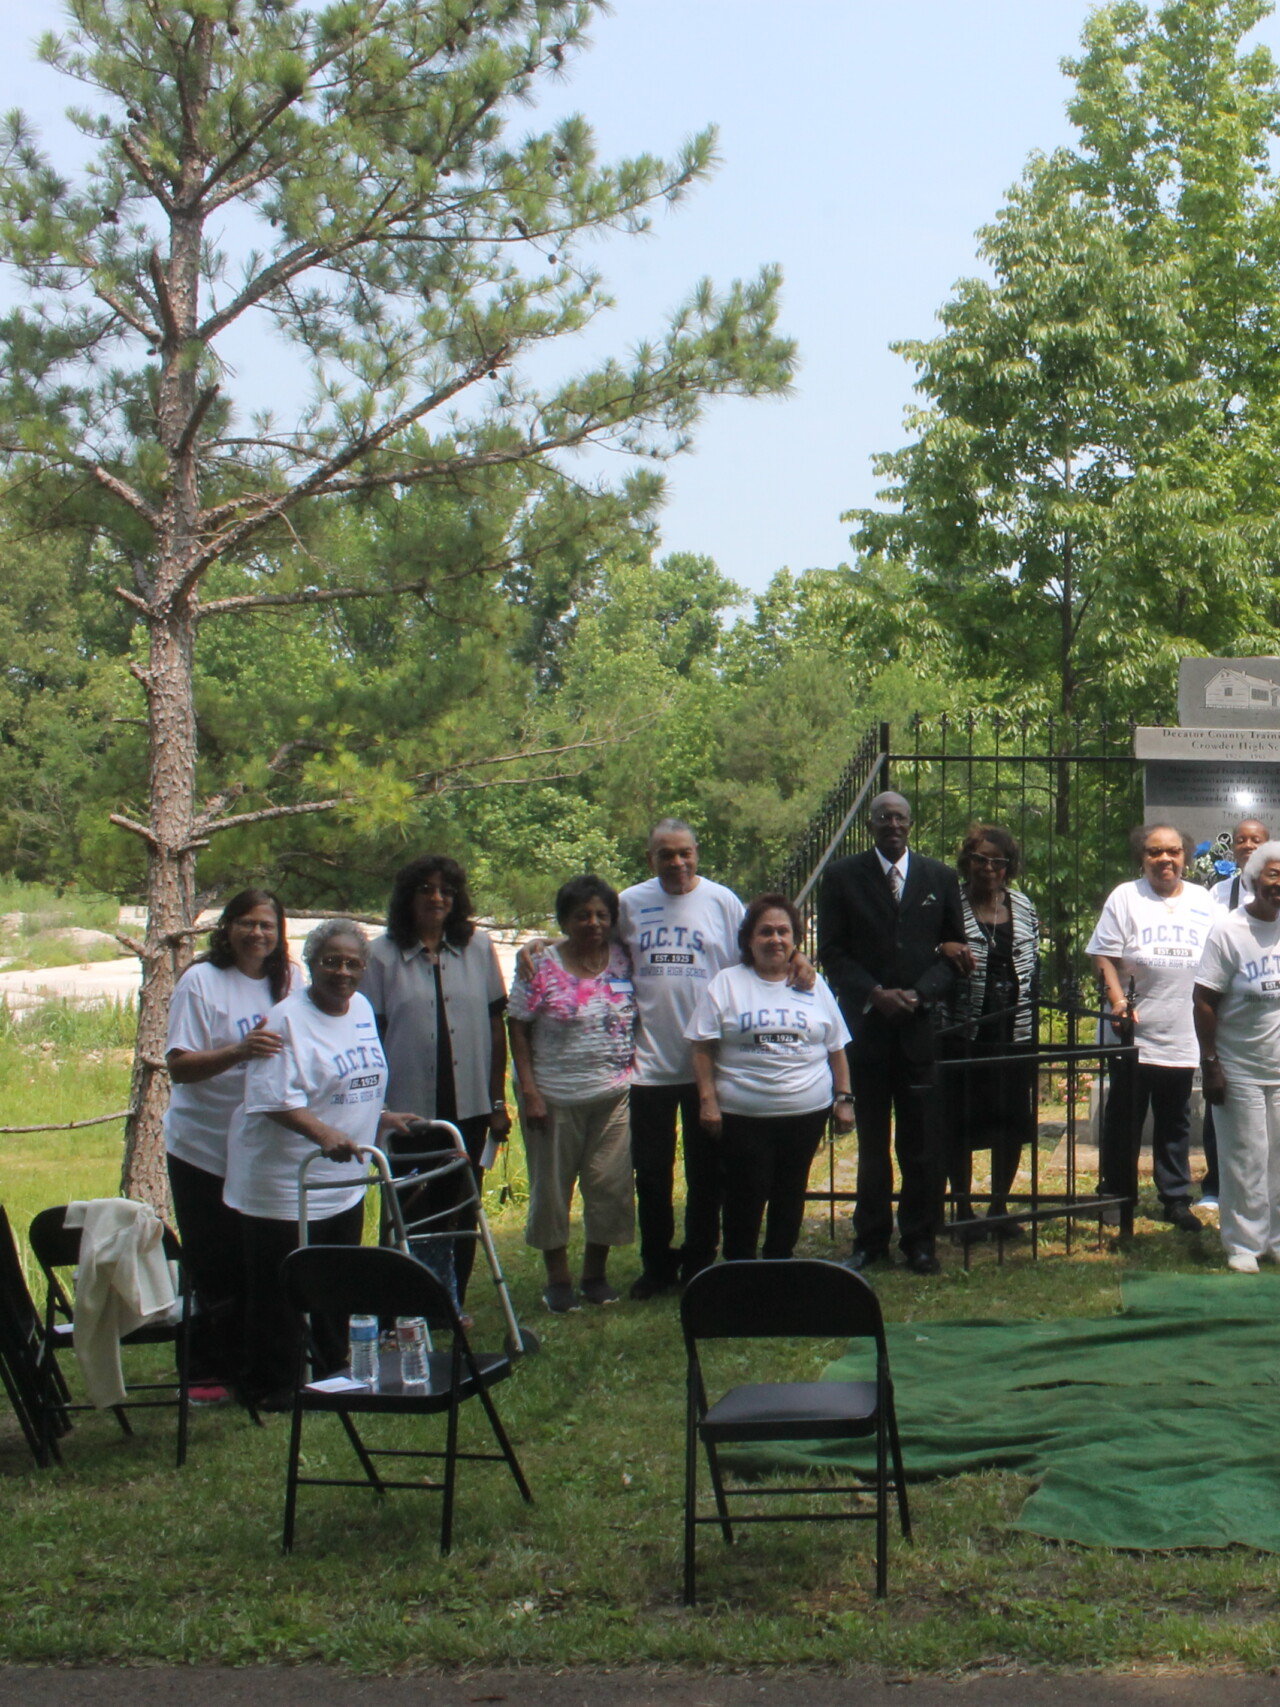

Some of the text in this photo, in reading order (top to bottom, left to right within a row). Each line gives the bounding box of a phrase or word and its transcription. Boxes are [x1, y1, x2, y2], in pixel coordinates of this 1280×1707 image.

[1162, 729, 1204, 738] Decatur
[1208, 731, 1246, 739] County
[1191, 741, 1234, 750] Crowder
[1239, 742, 1264, 752] High
[1221, 810, 1274, 822] The Faculty
[640, 926, 707, 955] D.C.T.S.
[1142, 924, 1204, 949] D.C.T.S.
[655, 954, 690, 963] EST. 1925
[1265, 981, 1279, 990] EST.
[741, 1008, 812, 1033] D.C.T.S.
[758, 1034, 794, 1043] EST. 1925
[362, 1077, 378, 1087] 1925
